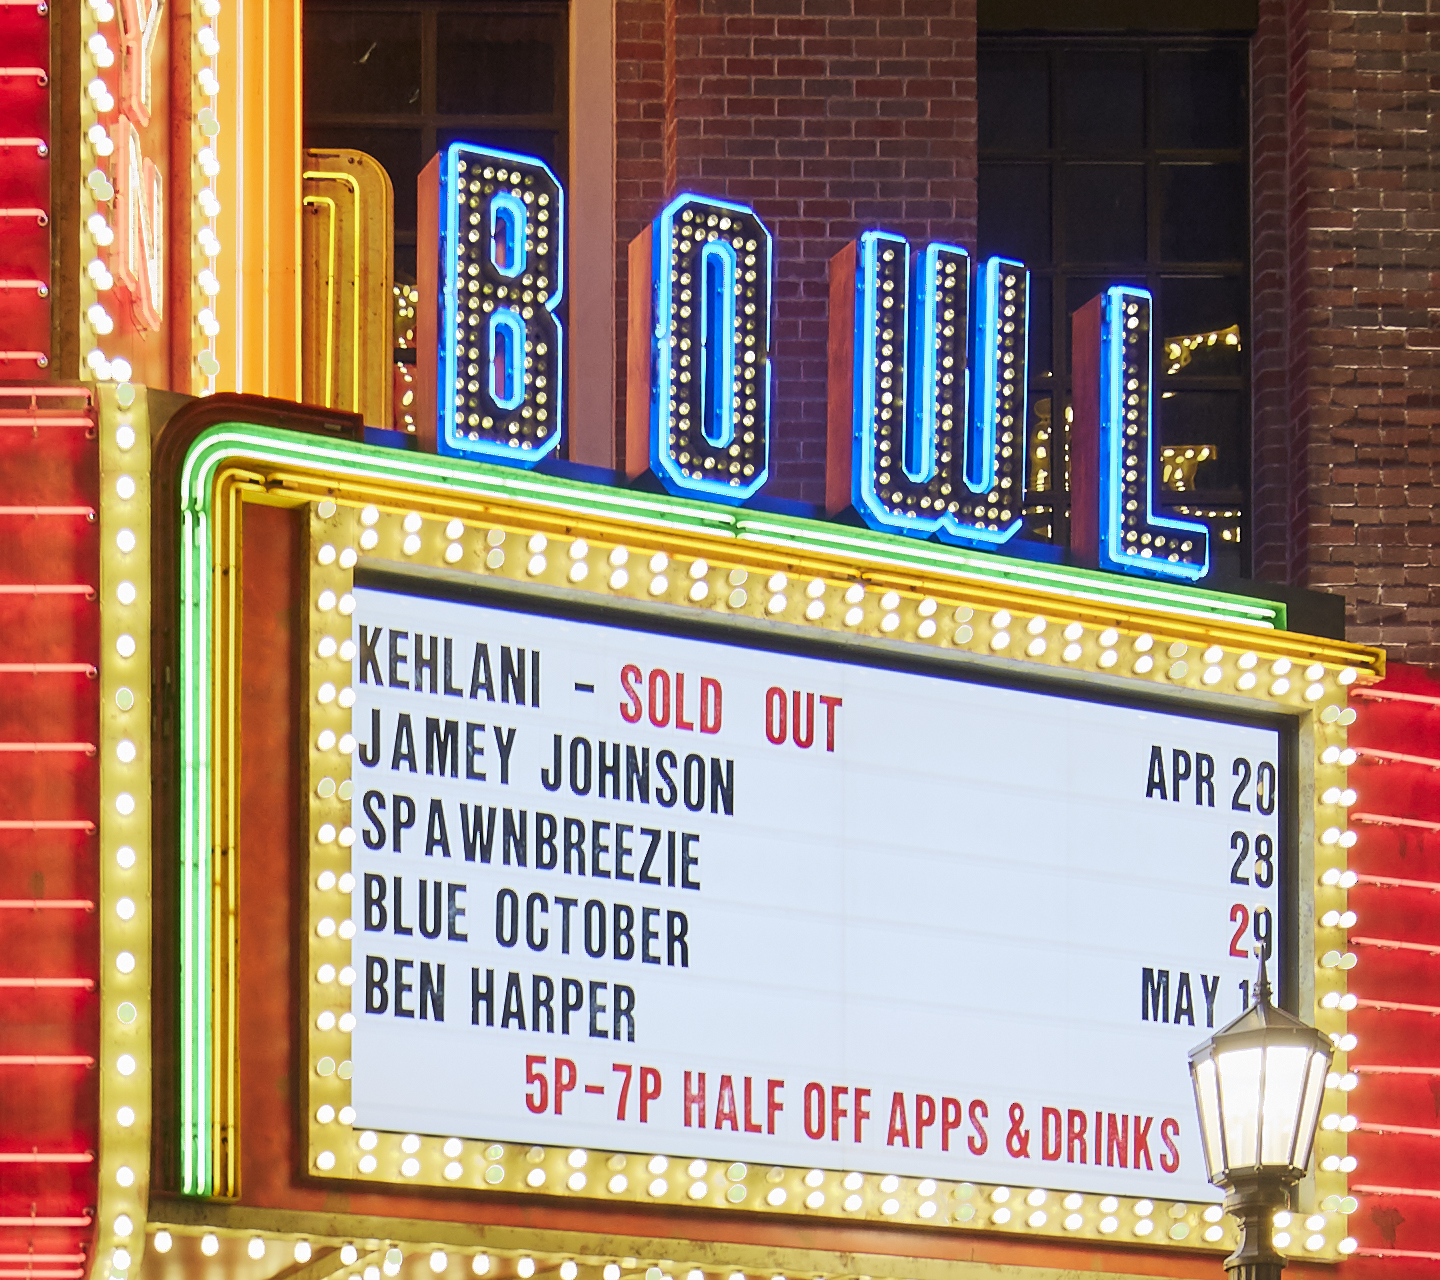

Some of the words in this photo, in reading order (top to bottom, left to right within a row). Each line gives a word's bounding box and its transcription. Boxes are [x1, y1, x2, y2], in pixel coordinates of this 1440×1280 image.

[445, 140, 1210, 582] BOWL
[357, 624, 541, 708] KEHLANI
[619, 663, 724, 735] SOLD
[765, 686, 843, 753] OUT
[358, 708, 517, 788] JAMEY
[541, 732, 735, 817] JOHNSON
[1146, 744, 1216, 810] APR
[1232, 756, 1277, 816] 20
[361, 789, 702, 891] SPAWNBREEZIE
[1230, 831, 1275, 889] 28
[363, 871, 468, 943] BLUE
[496, 886, 690, 969] OCTOBER
[1228, 902, 1273, 962] 29
[364, 955, 444, 1022] BEN
[471, 965, 636, 1043] HARPER
[1141, 967, 1220, 1028] MAY
[684, 1070, 785, 1135] HALF
[804, 1081, 870, 1145] OFF
[887, 1091, 988, 1156] APPS
